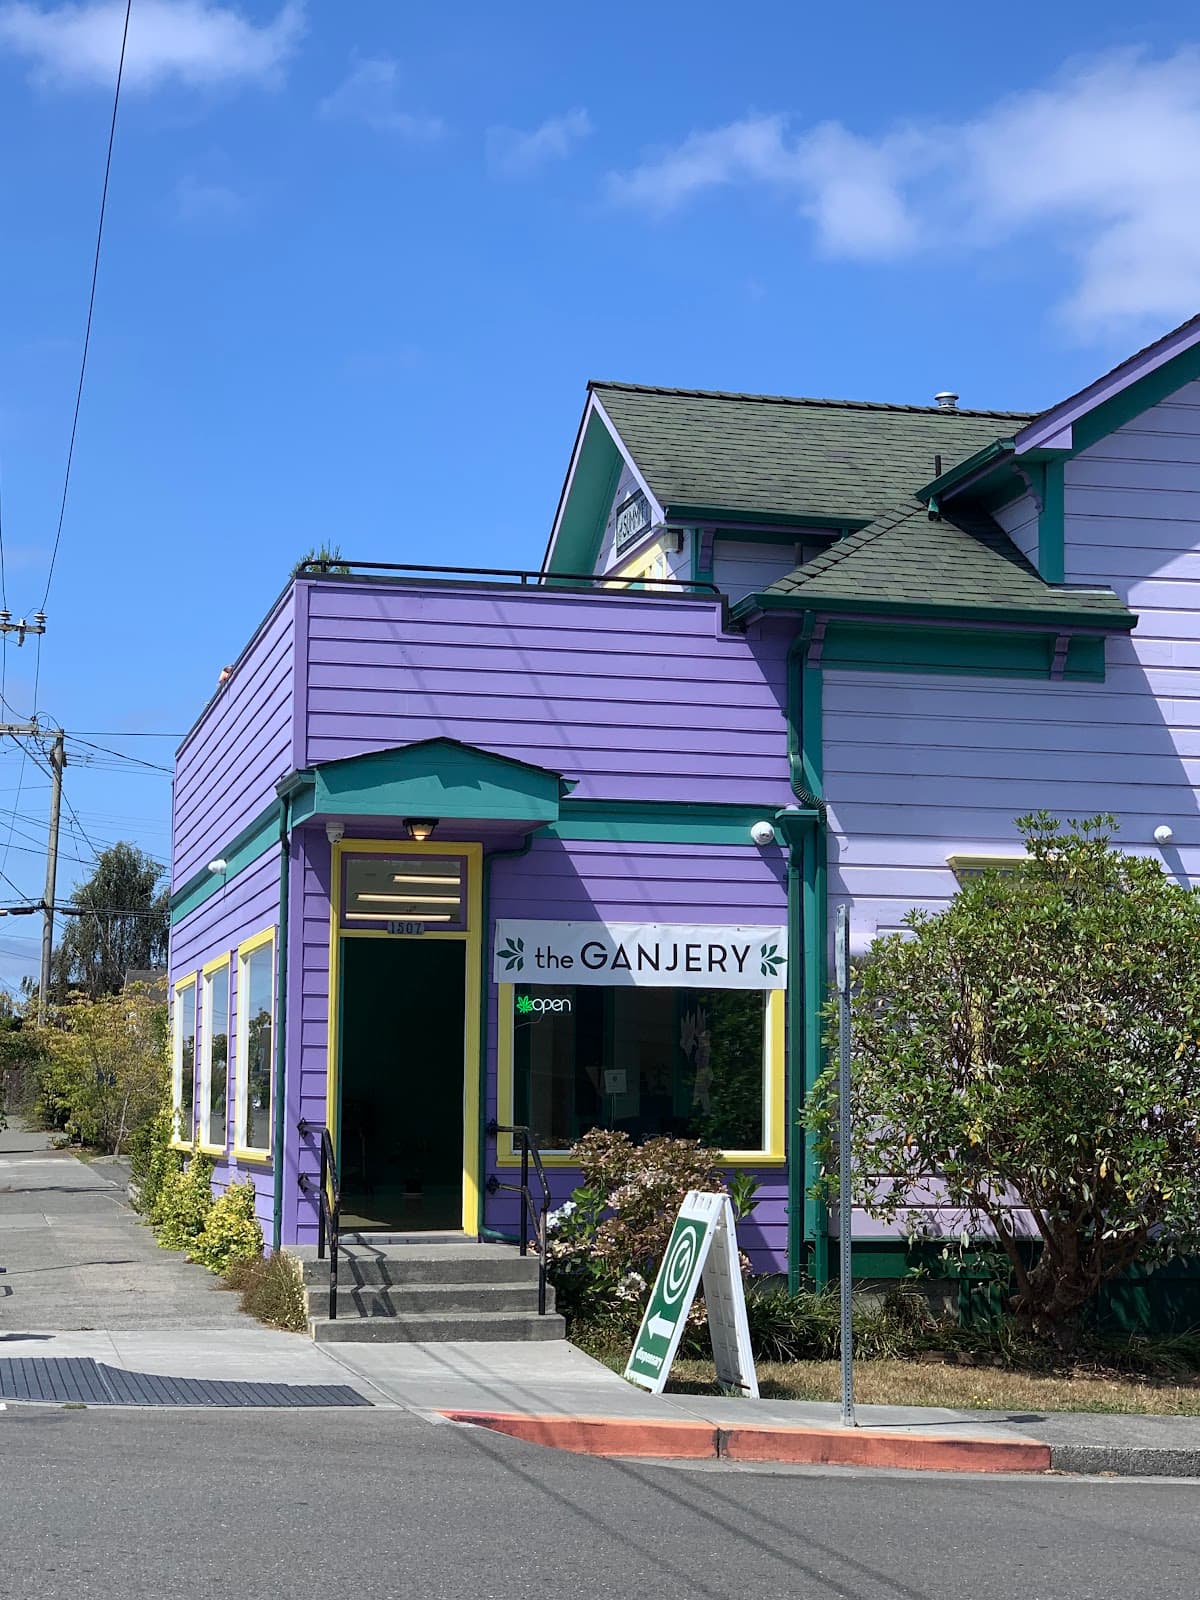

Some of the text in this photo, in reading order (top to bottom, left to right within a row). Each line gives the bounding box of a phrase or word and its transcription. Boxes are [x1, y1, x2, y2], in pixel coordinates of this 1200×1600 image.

[391, 920, 422, 935] 1507
[535, 941, 751, 973] the GANJERY
[532, 998, 572, 1015] open
